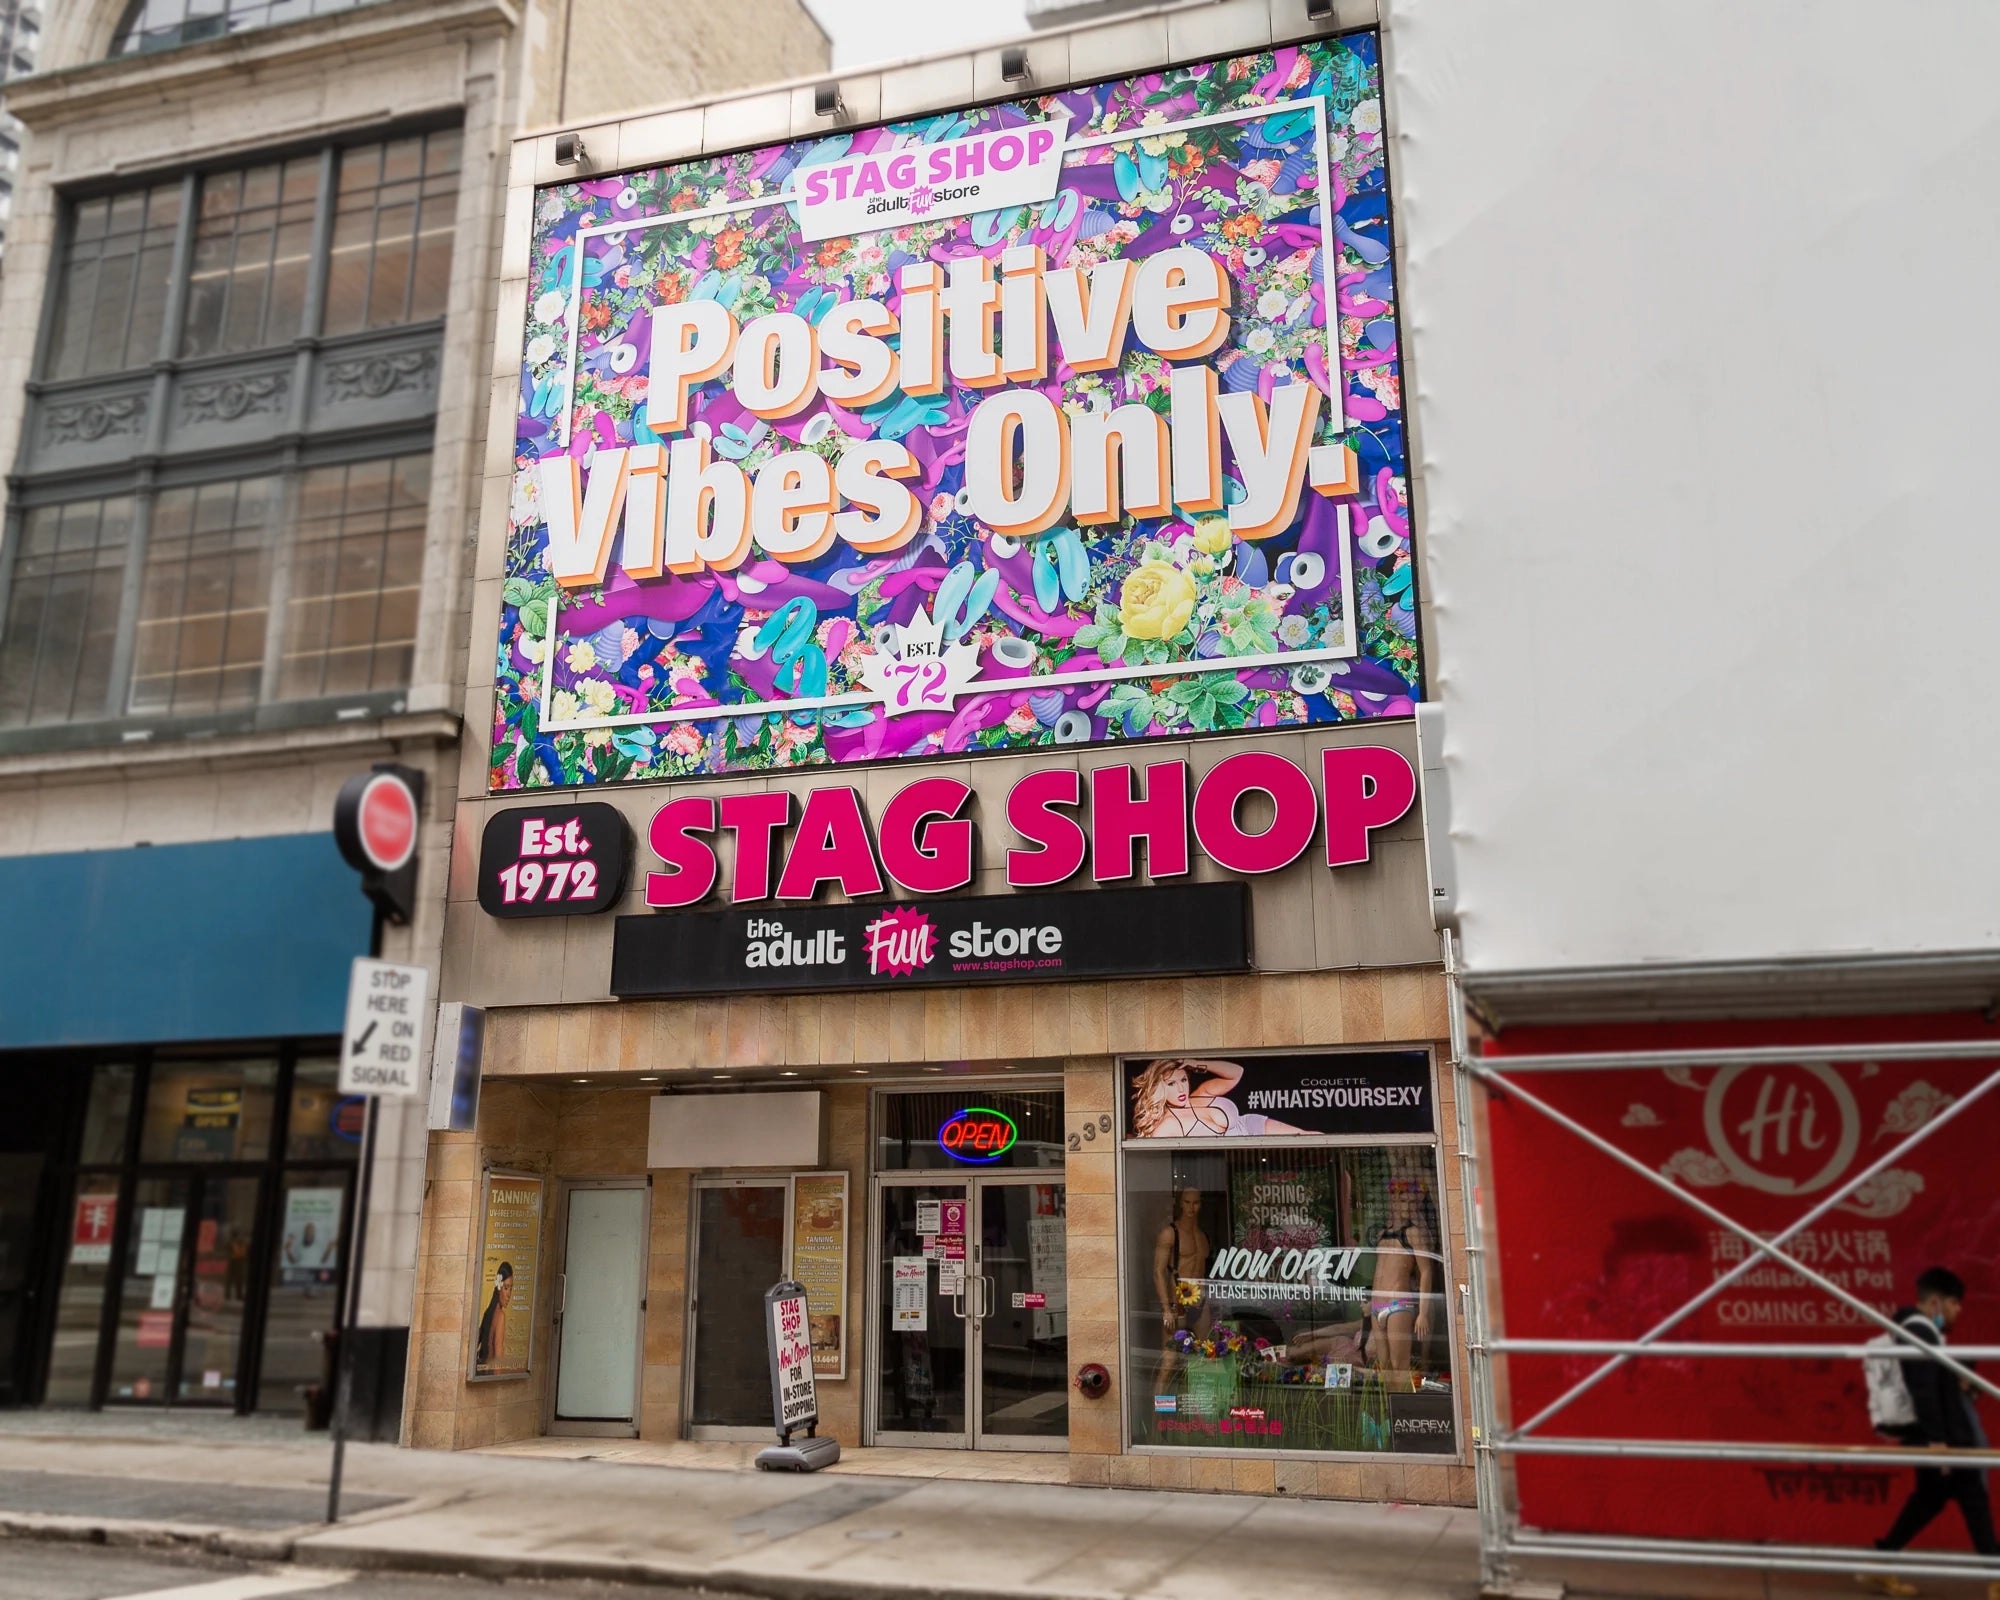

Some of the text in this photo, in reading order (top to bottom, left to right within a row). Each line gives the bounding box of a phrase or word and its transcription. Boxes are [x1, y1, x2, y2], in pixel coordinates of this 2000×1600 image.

[805, 129, 1054, 207] STAG SHOP
[866, 185, 980, 215] adult Fun store
[646, 244, 1231, 433] Positive
[539, 365, 1358, 588] Vibes Only.
[906, 642, 936, 657] EST.
[518, 816, 592, 859] Est.
[644, 745, 1417, 909] STAG SHOP
[498, 859, 600, 906] 1972
[747, 918, 783, 939] the
[745, 918, 1062, 976] adult Fun store
[952, 957, 1063, 973] www.stagshop.com
[371, 970, 411, 990] STOP
[367, 994, 408, 1015] HERE
[391, 1020, 413, 1038] ON
[379, 1043, 411, 1062] RED
[351, 1065, 409, 1087] SIGNAL
[1300, 1077, 1367, 1087] COQUETTE
[1248, 1086, 1423, 1110] #WHATSYOURSEXY
[1737, 1074, 1827, 1162] Hi
[943, 1121, 1011, 1149] OPEN
[1067, 1114, 1112, 1151] 239
[492, 1189, 537, 1205] TANNING
[1708, 1230, 1891, 1263] 海捞火锅
[1209, 1247, 1361, 1281] NOW OPEN
[1811, 1270, 1850, 1290] ot
[1855, 1270, 1893, 1290] Pot
[1208, 1285, 1367, 1301] PLEASE DISTANCE 6 FT. IN LINE
[780, 1299, 799, 1316] STAG
[1716, 1301, 1817, 1323] COMING
[782, 1315, 801, 1332] SHOP
[794, 1342, 810, 1365] Open
[790, 1366, 802, 1382] FOR
[783, 1381, 812, 1402] IN-STORE
[784, 1398, 815, 1420] SHOPPING
[1394, 1419, 1450, 1429] ANDREW
